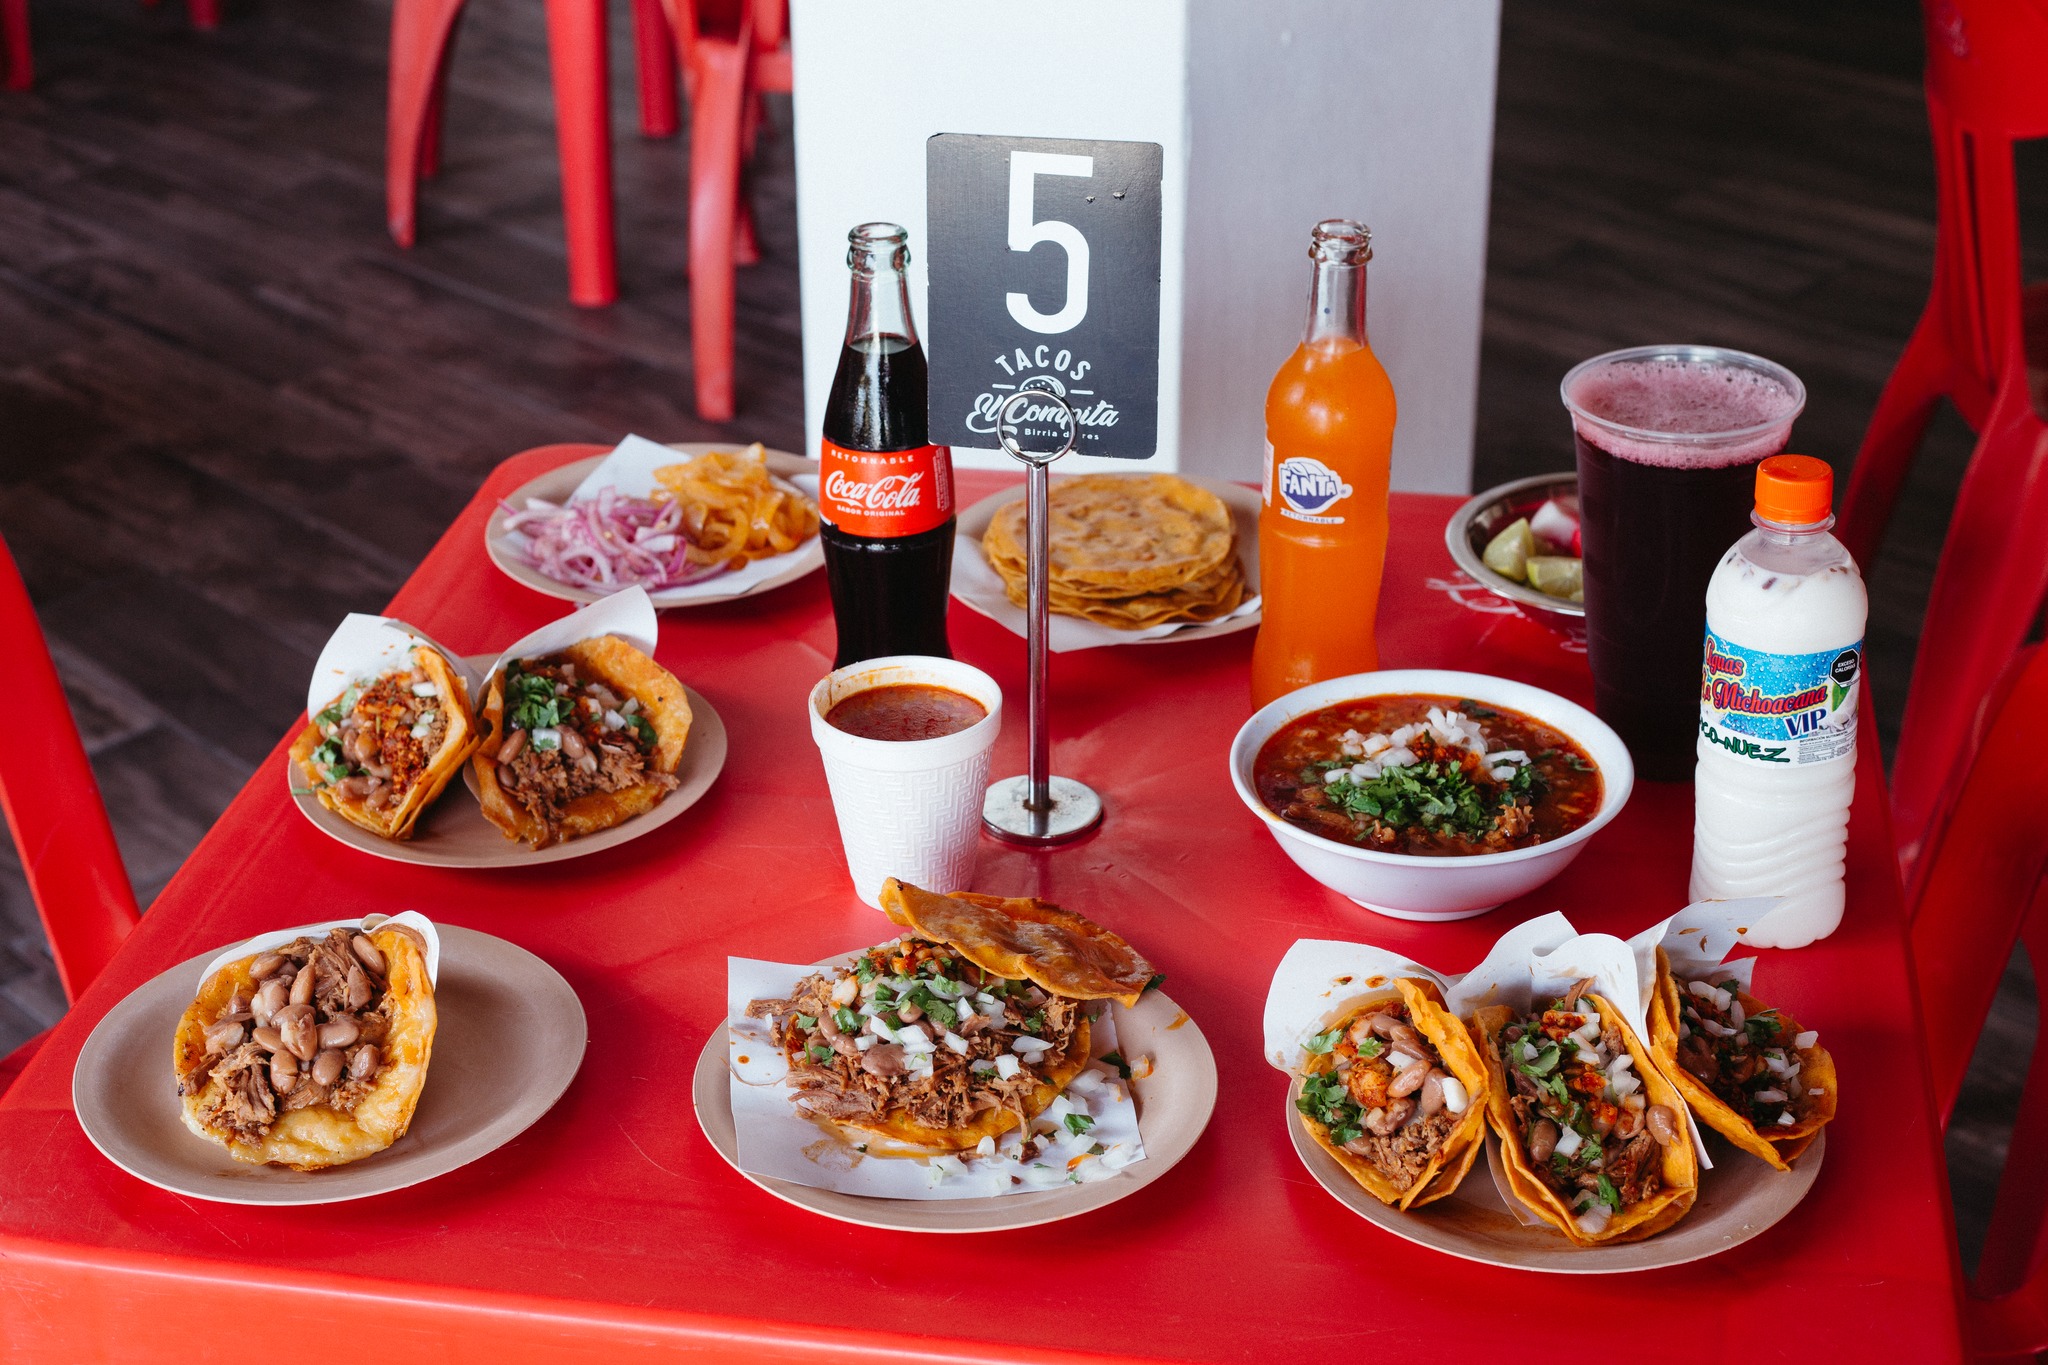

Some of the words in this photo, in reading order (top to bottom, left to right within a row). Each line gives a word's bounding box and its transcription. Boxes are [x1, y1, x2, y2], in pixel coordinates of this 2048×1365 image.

[1006, 151, 1094, 334] 5
[994, 345, 1092, 381] TACOS
[965, 393, 1018, 435] El
[1024, 428, 1058, 437] Birria
[830, 449, 914, 465] RETORNABLE
[825, 470, 925, 509] Coca-Cola
[1280, 467, 1338, 497] FANTA
[836, 505, 862, 516] SABOR
[863, 509, 906, 517] ORIGINAL
[1283, 510, 1336, 524] RETORNABLE
[1712, 678, 1828, 715] Michoacana
[1786, 709, 1827, 736] VIP
